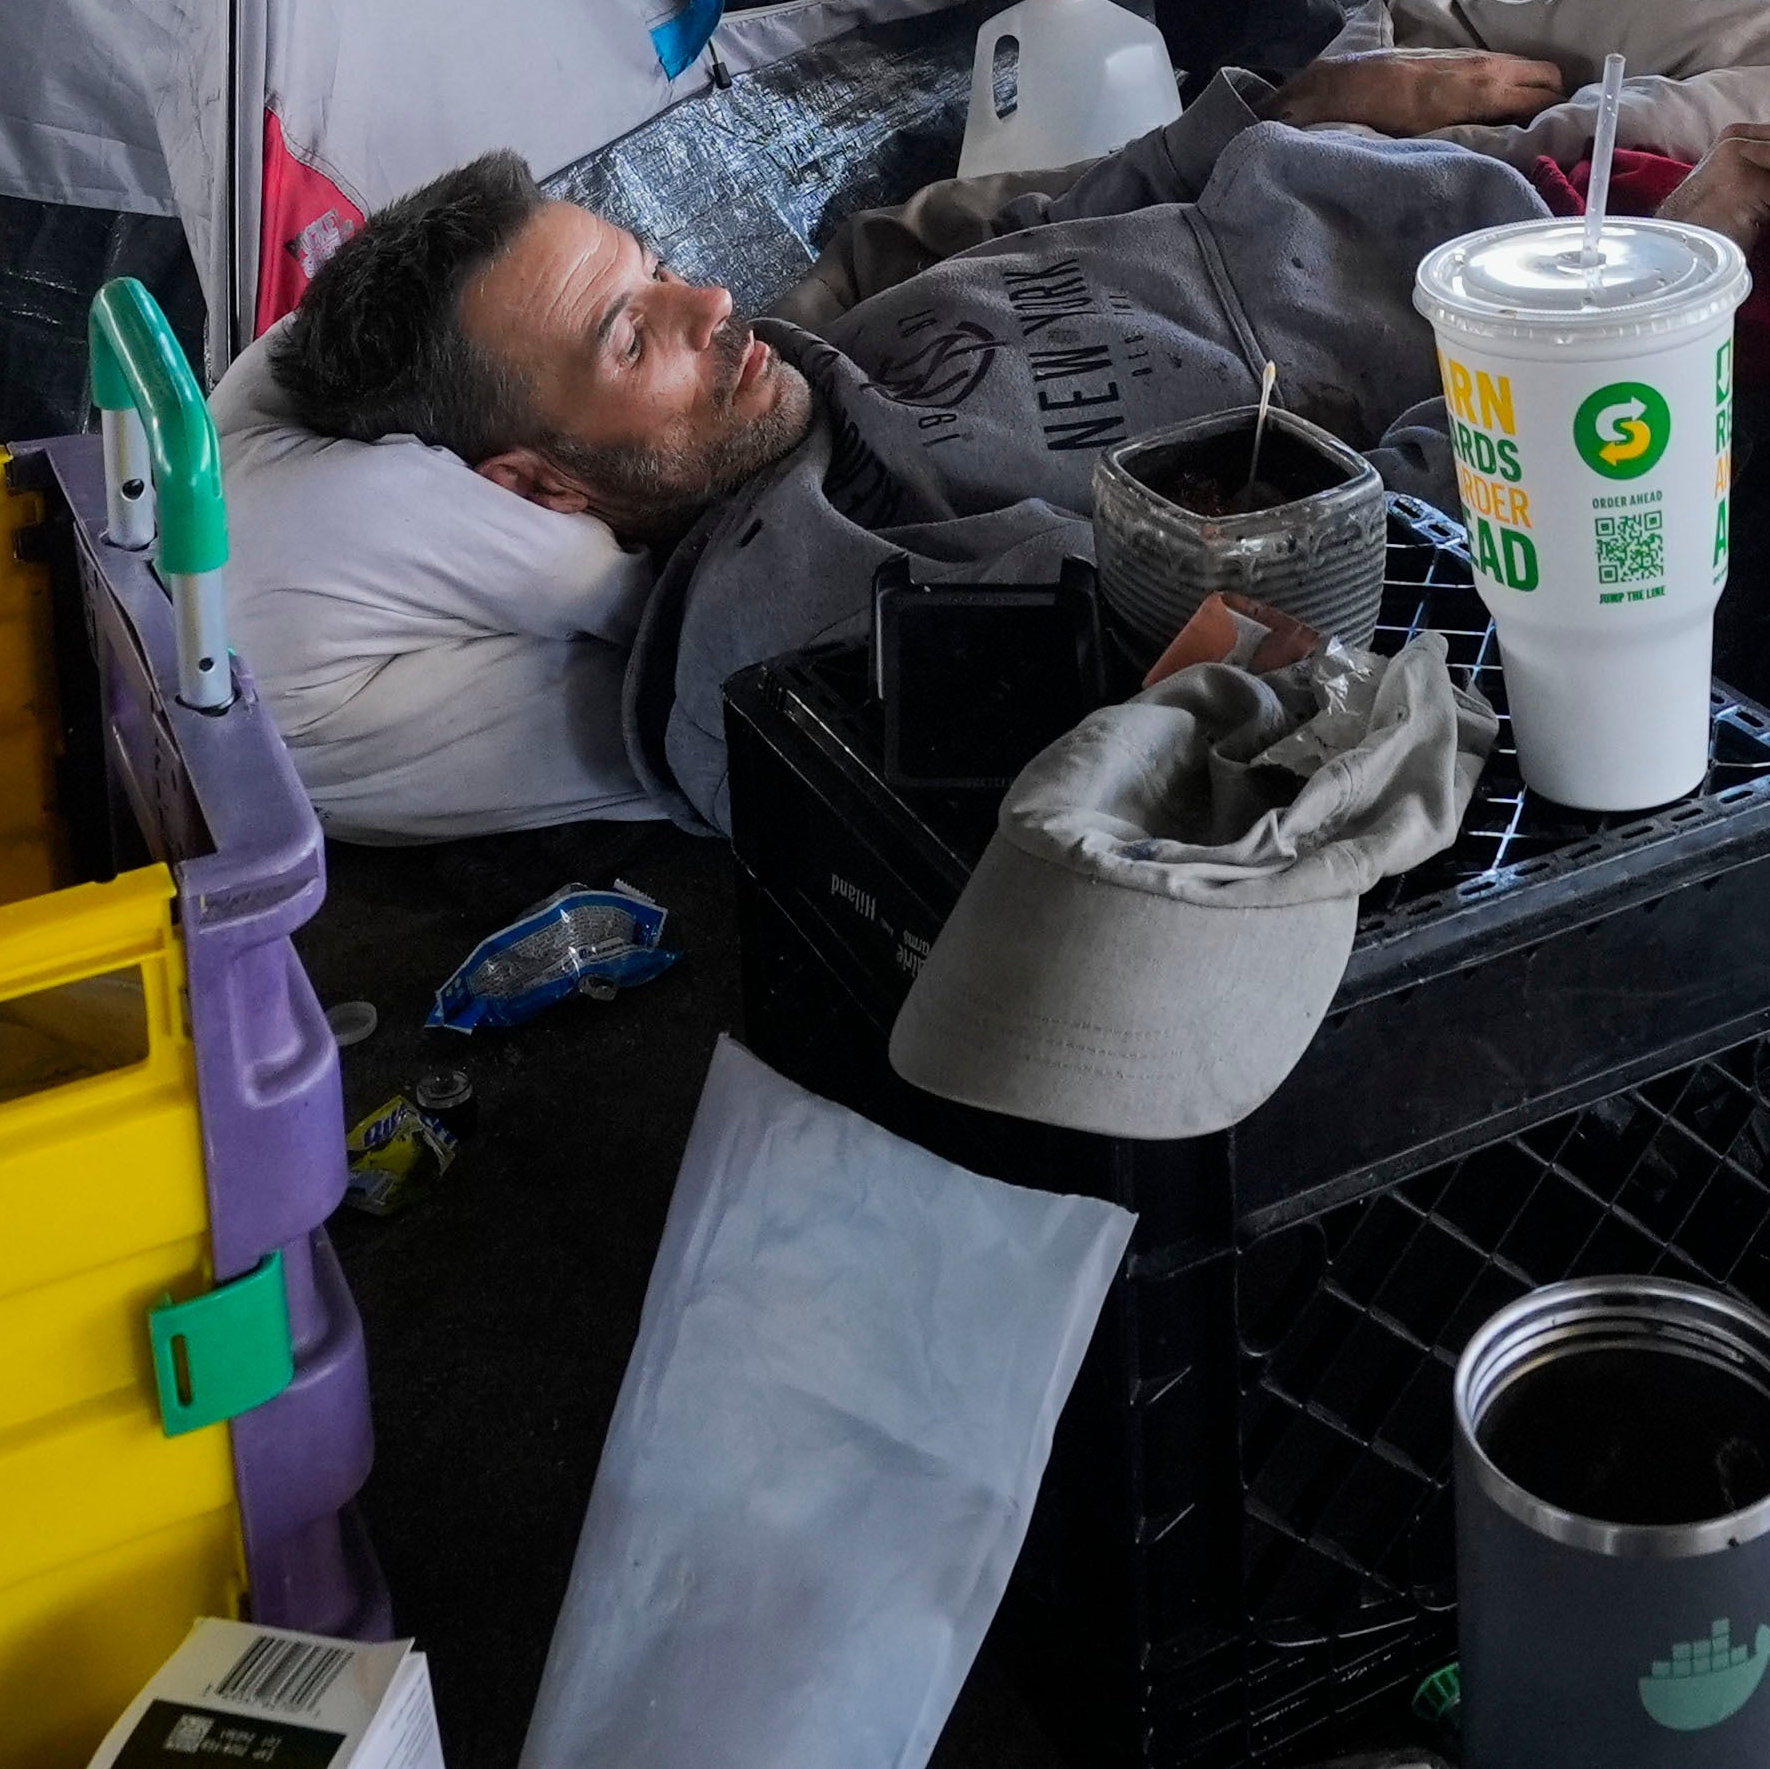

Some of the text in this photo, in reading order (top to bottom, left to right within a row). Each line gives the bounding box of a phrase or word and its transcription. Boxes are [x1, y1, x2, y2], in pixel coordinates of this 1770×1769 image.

[1003, 258, 1128, 451] NEW YORK
[1436, 348, 1517, 436] RN
[1448, 412, 1522, 482] ARDS
[1458, 465, 1534, 529] RDER
[1592, 490, 1663, 509] ORDER AHEAD
[1462, 504, 1539, 593] EAD
[1599, 585, 1666, 604] JUMP THE LINE
[830, 872, 877, 922] Hiland
[901, 928, 931, 957] arms
